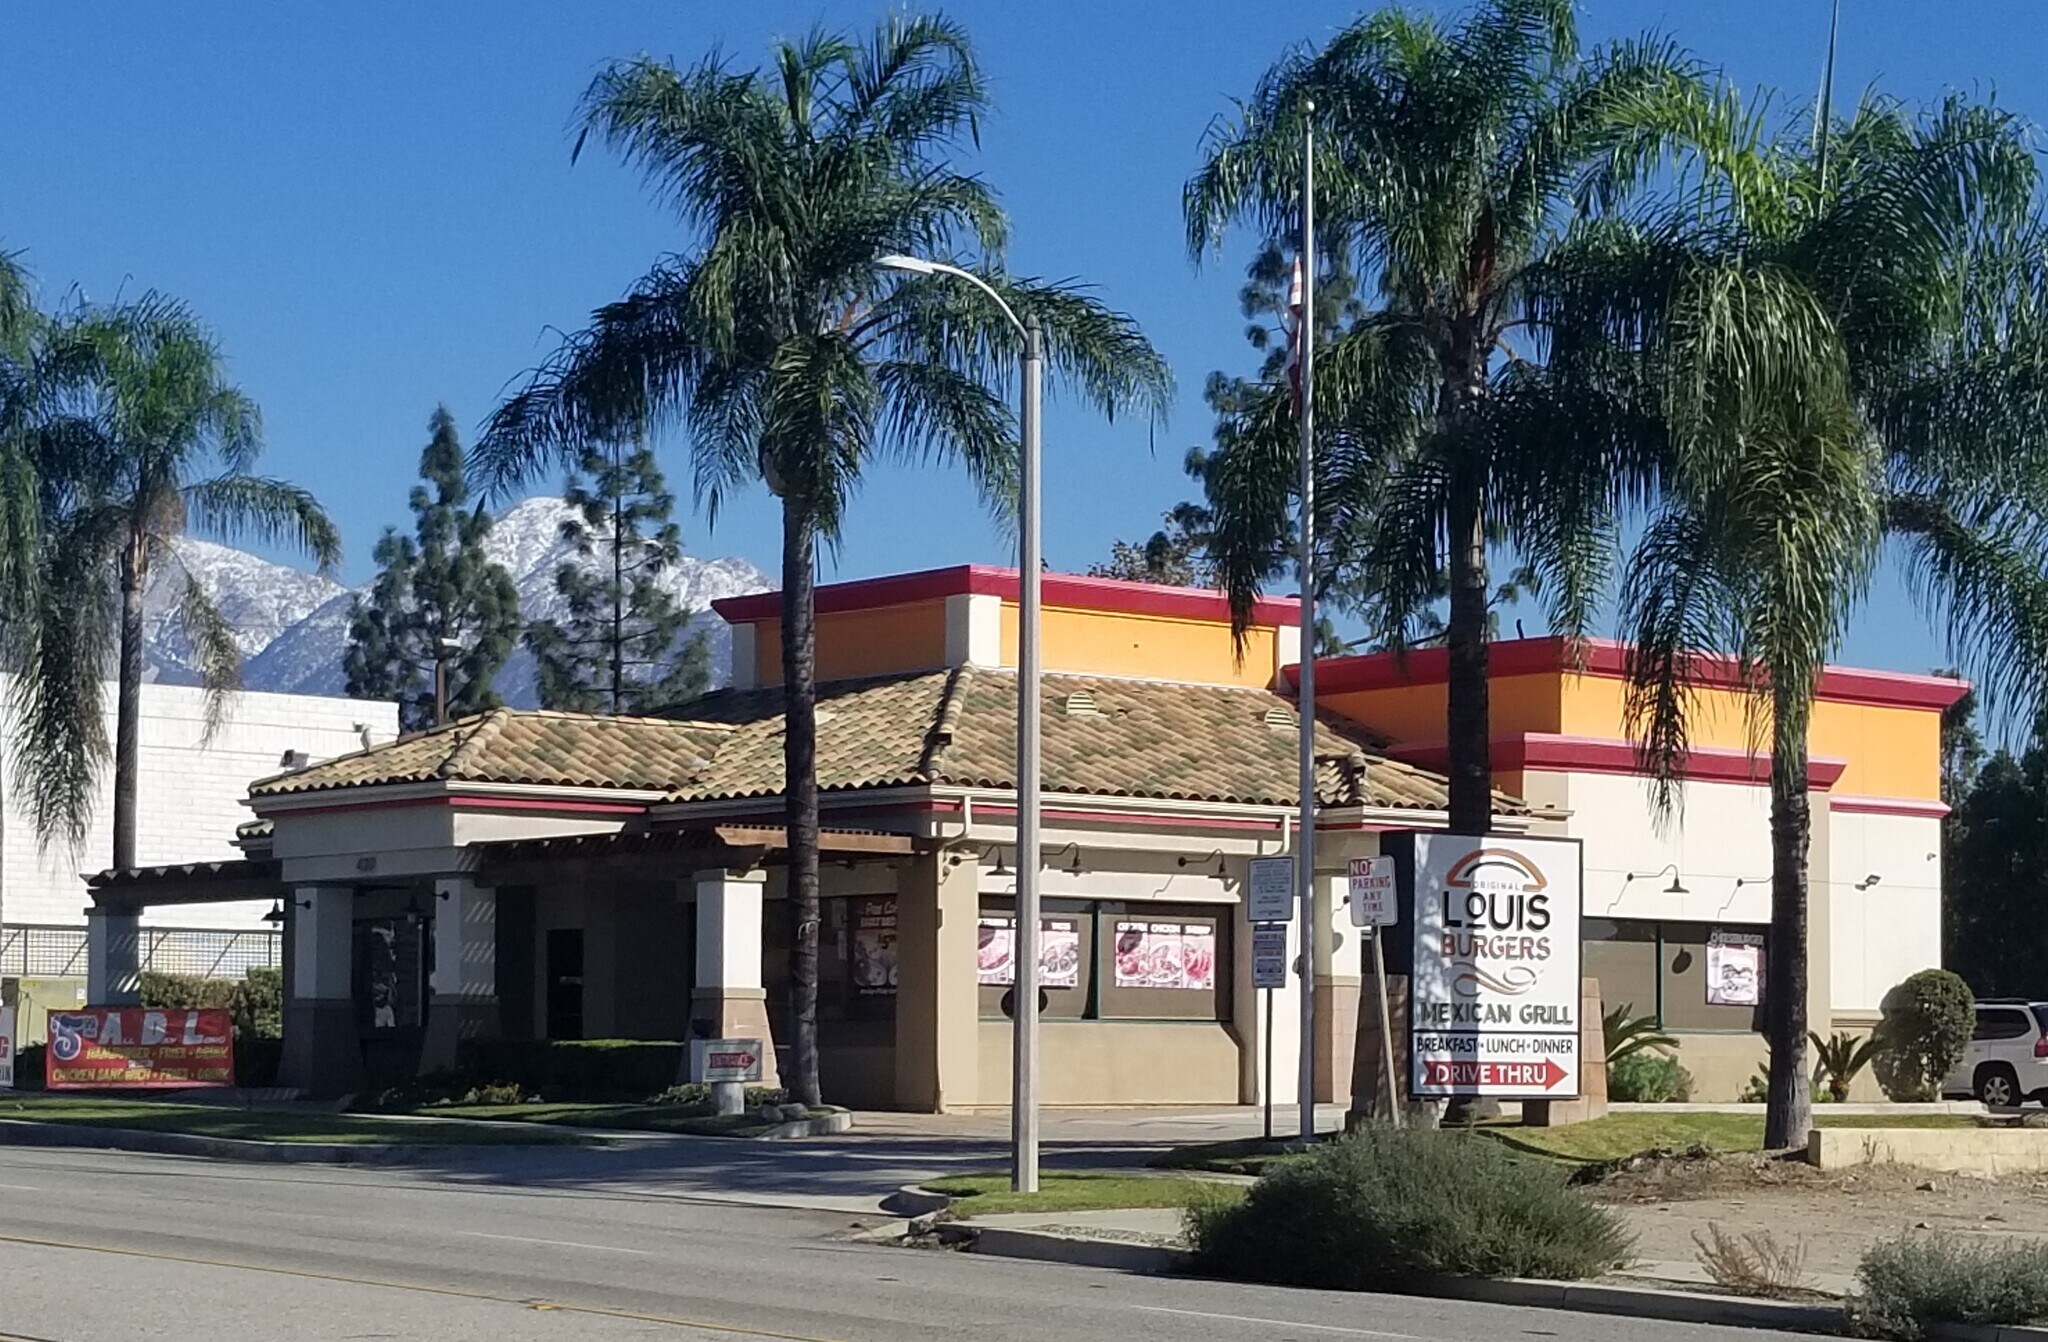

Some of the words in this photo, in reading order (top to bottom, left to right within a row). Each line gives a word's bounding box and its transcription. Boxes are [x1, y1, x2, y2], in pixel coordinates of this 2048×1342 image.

[1350, 861, 1368, 875] NO
[1352, 877, 1391, 889] PARKING
[1473, 881, 1520, 891] ORIGINAL
[1363, 891, 1382, 900] ANY
[1363, 902, 1383, 912] TIME
[1442, 891, 1551, 932] LOUIS
[1441, 933, 1551, 960] BURGERS
[1420, 1003, 1512, 1024] MEXICAN
[1519, 1004, 1574, 1025] GRILL
[1416, 1037, 1478, 1053] BREAKFAST
[1486, 1038, 1525, 1053] LUNCH
[1532, 1039, 1573, 1053] DINNER
[1436, 1064, 1492, 1083] DRIVE
[1496, 1065, 1547, 1083] THRU
